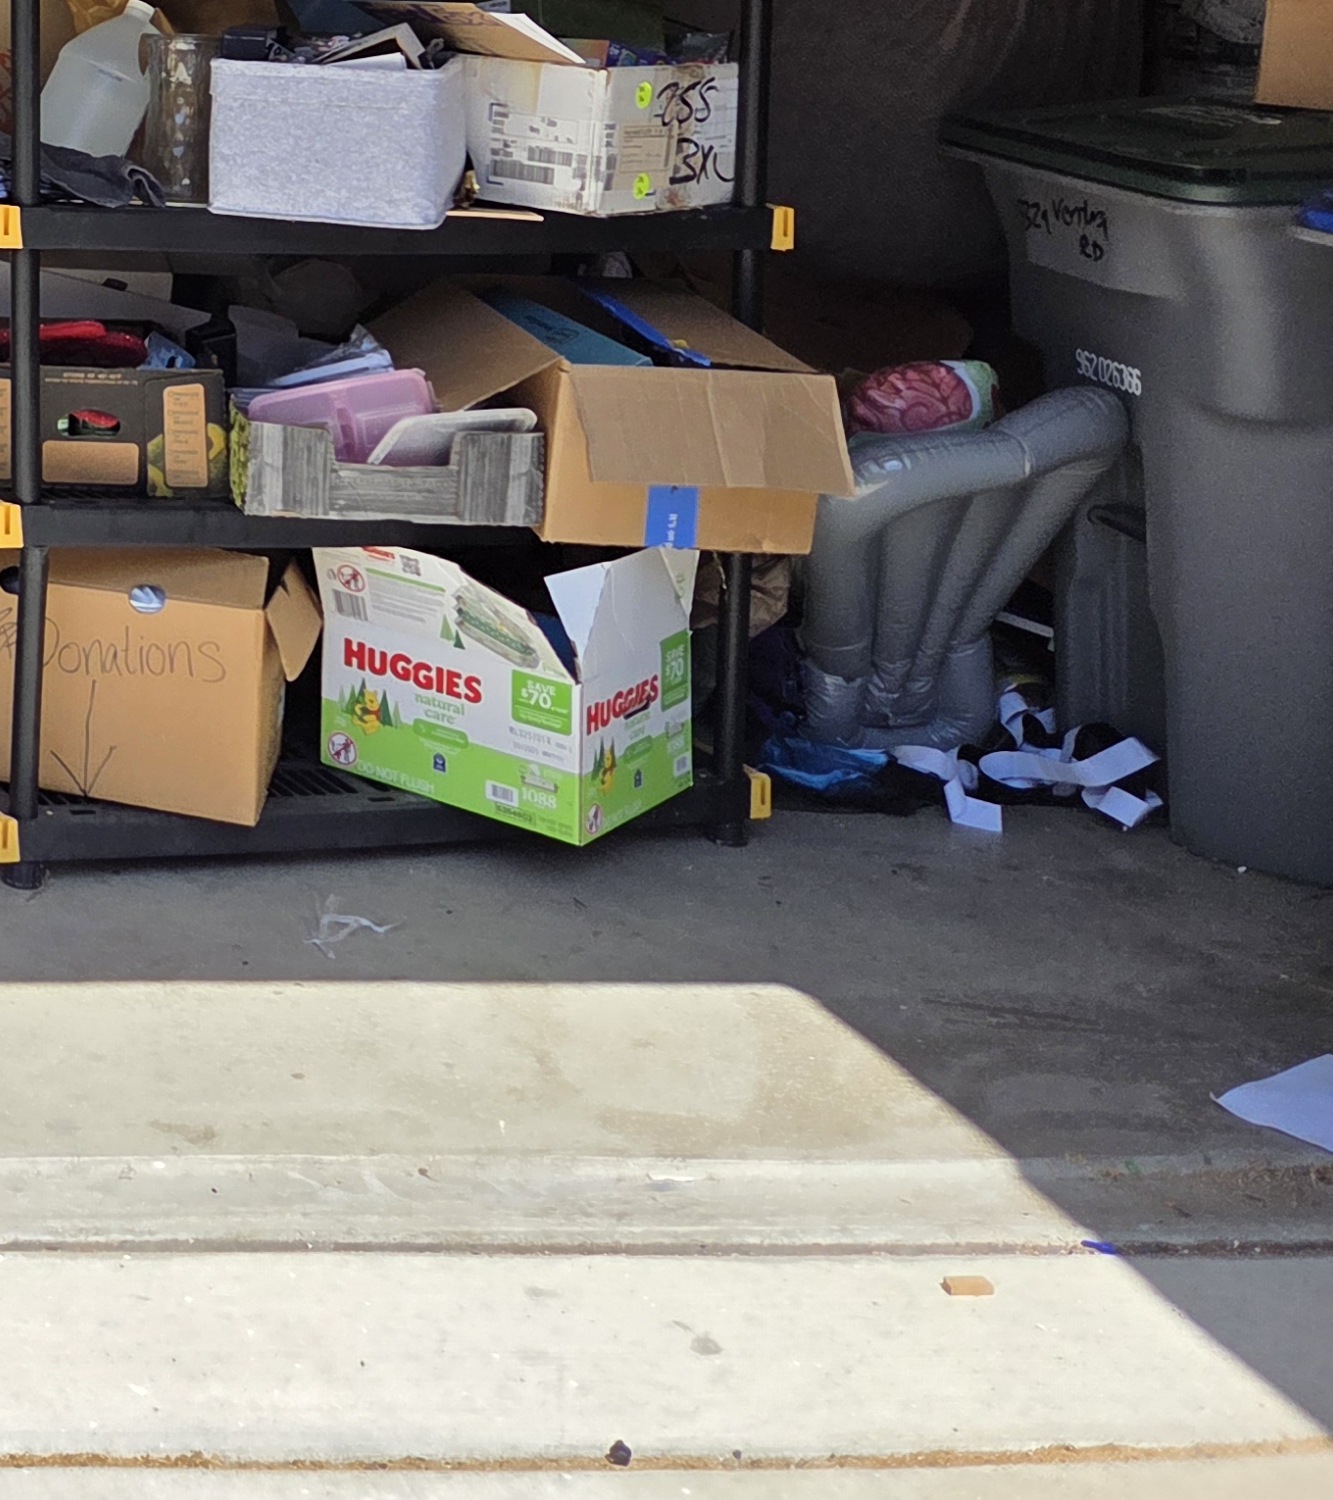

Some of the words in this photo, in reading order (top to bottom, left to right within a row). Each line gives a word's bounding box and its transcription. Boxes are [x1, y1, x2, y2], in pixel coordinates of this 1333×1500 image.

[343, 637, 483, 704] HUGGIES
[520, 686, 552, 710] $70
[526, 679, 557, 696] SAVE
[414, 692, 465, 716] natural
[586, 674, 659, 736] HUGGIES
[424, 709, 457, 725] care
